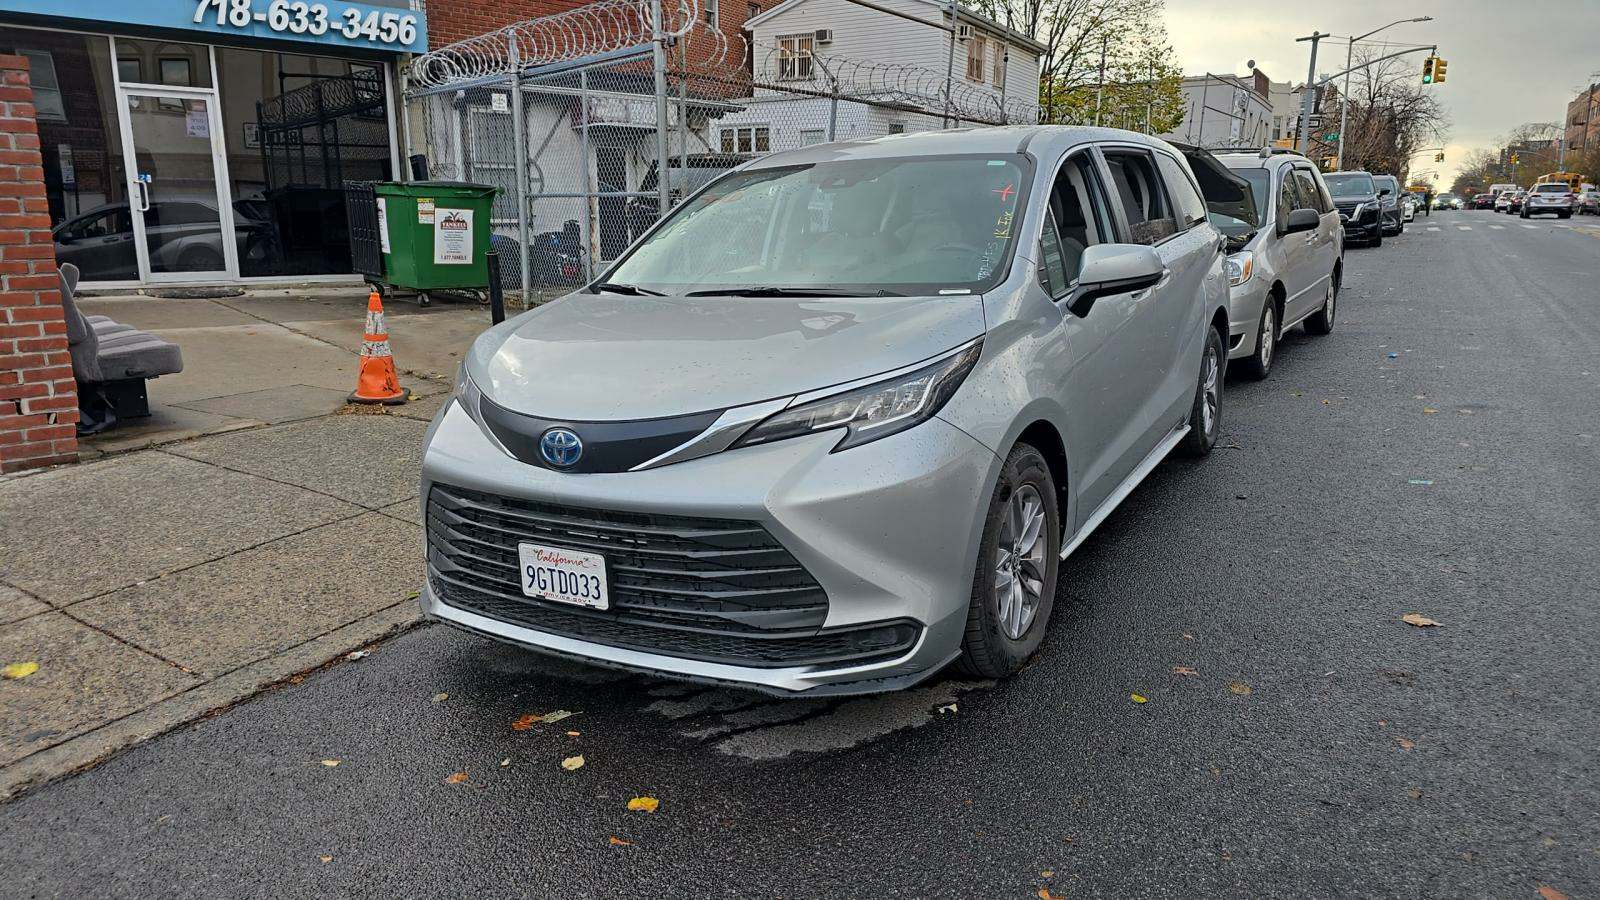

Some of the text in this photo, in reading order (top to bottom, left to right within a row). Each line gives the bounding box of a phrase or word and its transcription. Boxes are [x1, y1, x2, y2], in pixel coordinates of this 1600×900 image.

[193, 0, 417, 45] 718-633-3456
[536, 549, 589, 568] California
[526, 564, 601, 600] 9GTD033
